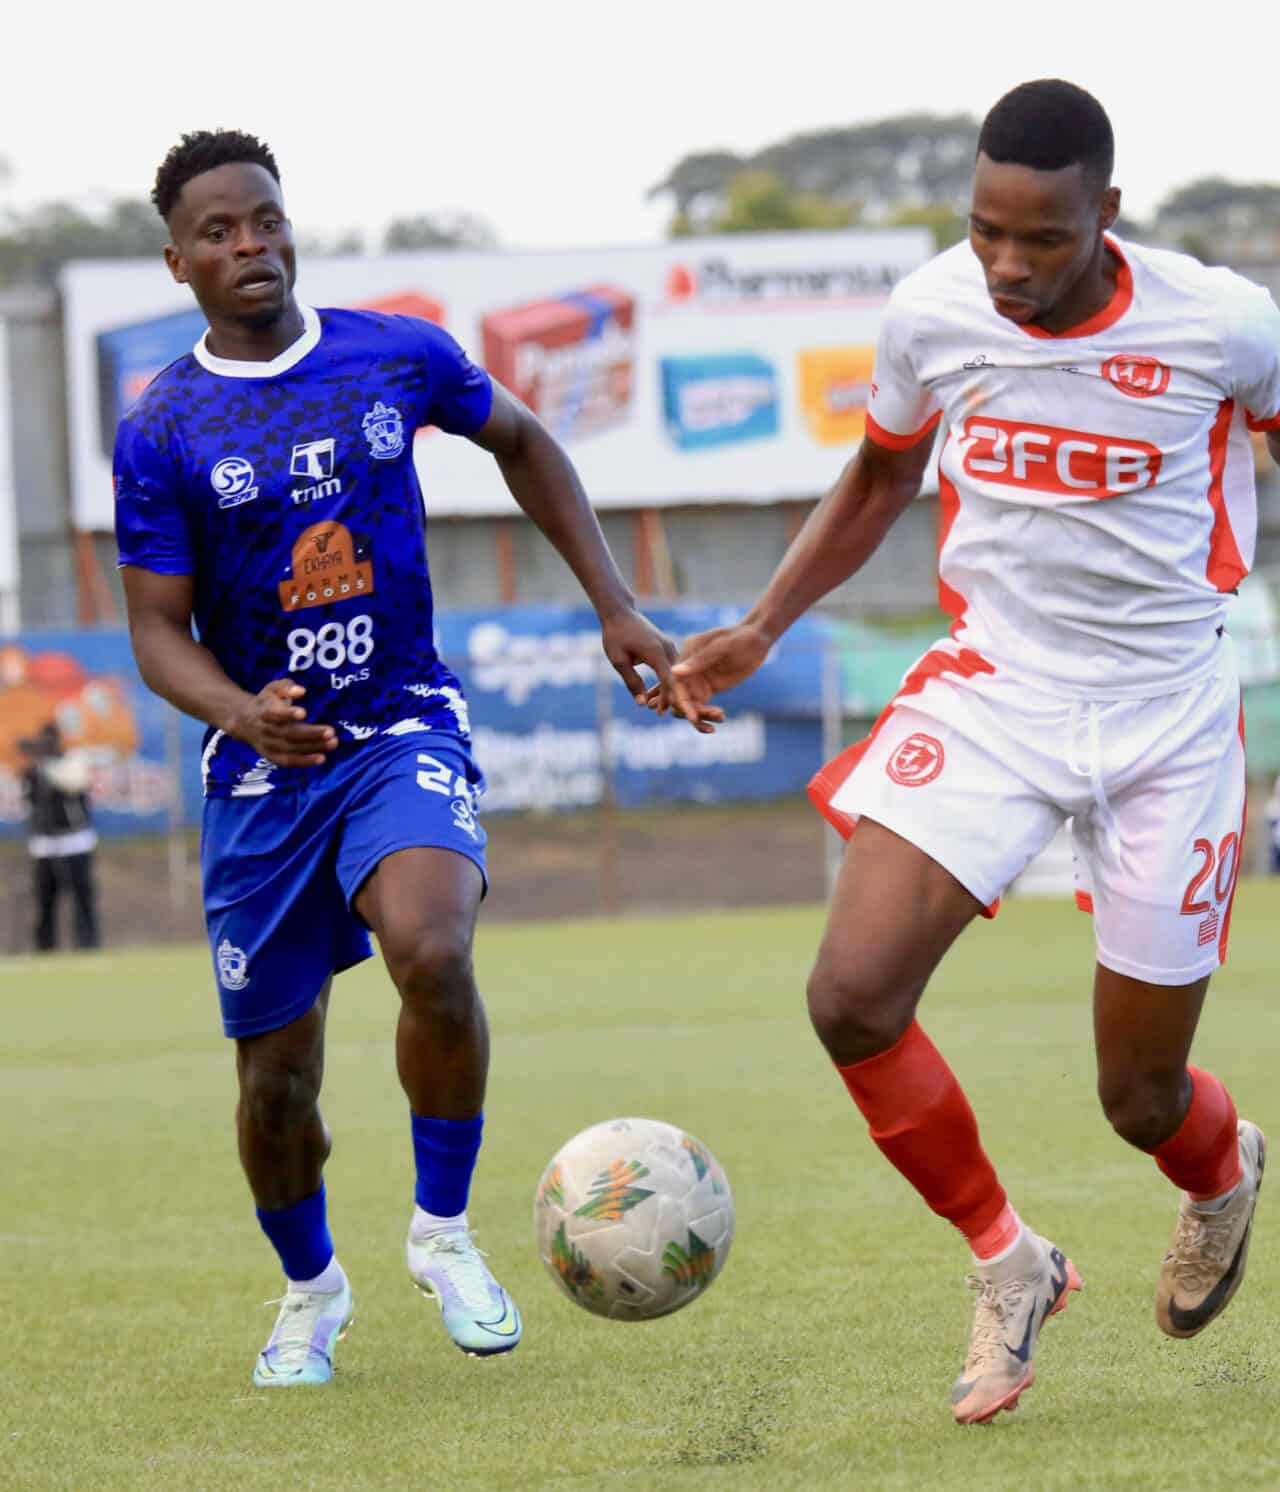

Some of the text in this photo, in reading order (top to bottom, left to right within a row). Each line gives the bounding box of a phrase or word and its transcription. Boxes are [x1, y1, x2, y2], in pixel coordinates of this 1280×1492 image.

[290, 477, 342, 505] tnm
[290, 578, 366, 605] FOODS
[286, 613, 375, 673] 888
[1179, 830, 1239, 915] 20
